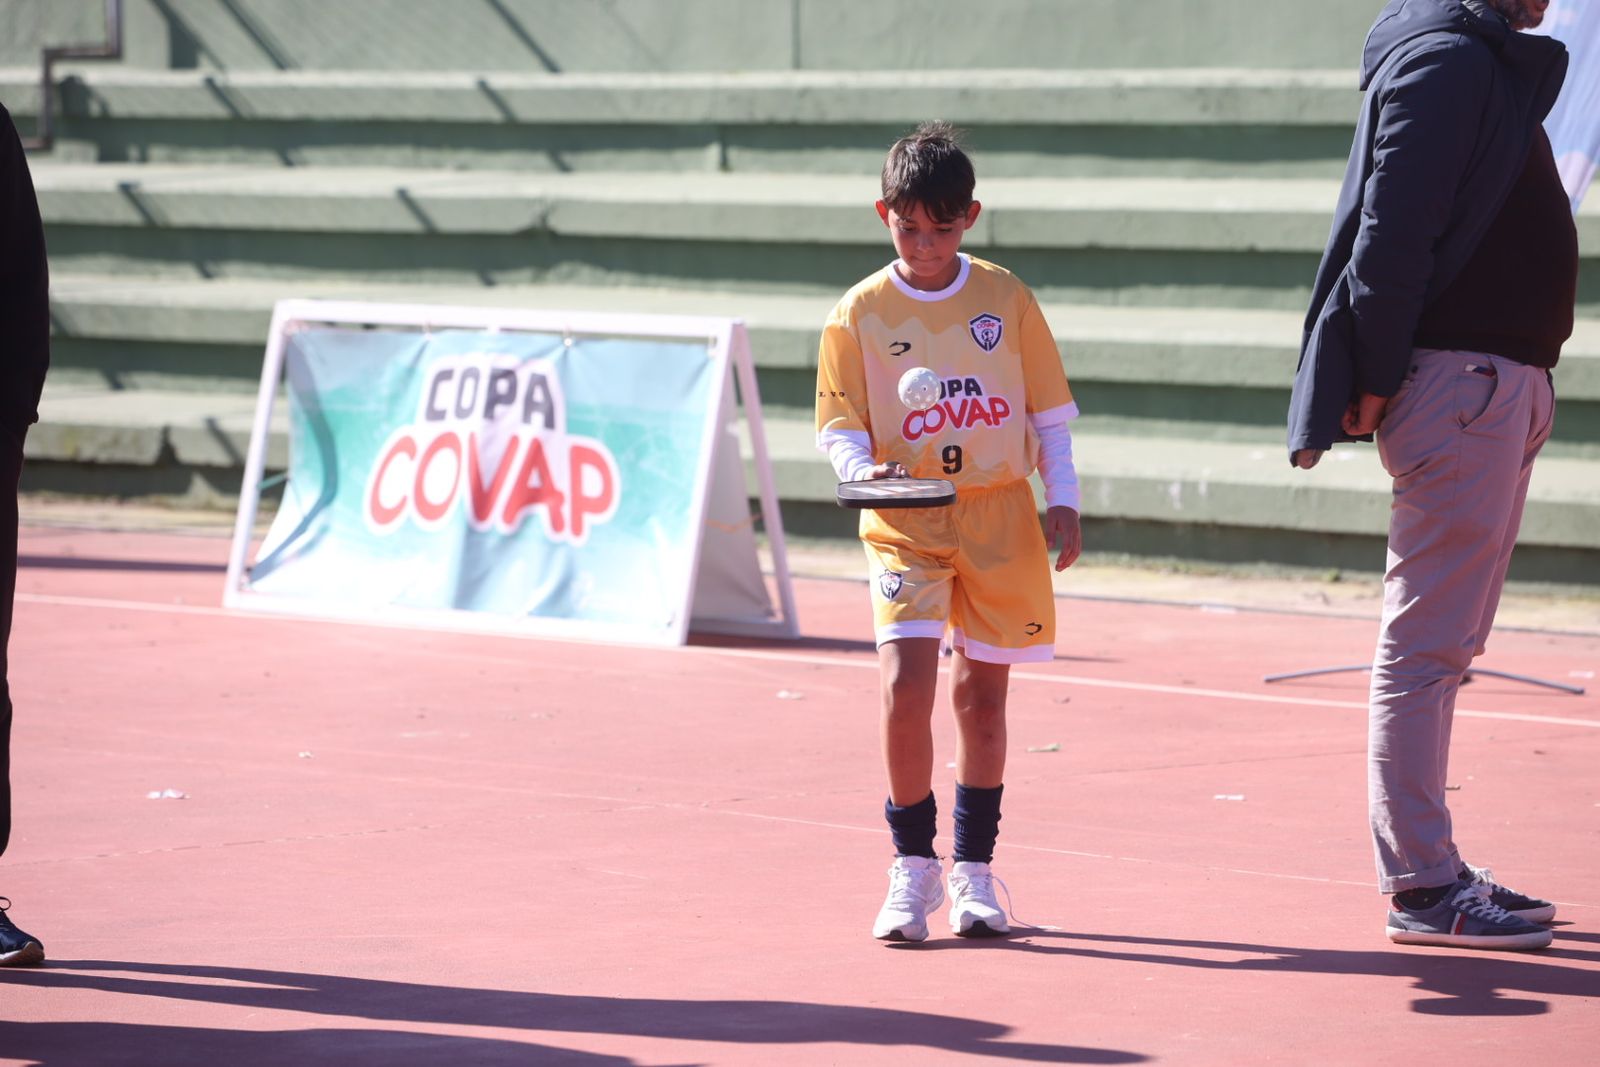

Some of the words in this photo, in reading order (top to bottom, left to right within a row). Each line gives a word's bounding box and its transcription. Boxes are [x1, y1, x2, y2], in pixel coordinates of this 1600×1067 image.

[424, 366, 556, 430] COPA
[902, 397, 1010, 441] COVAP
[370, 431, 614, 537] COVAP
[941, 445, 963, 475] 9
